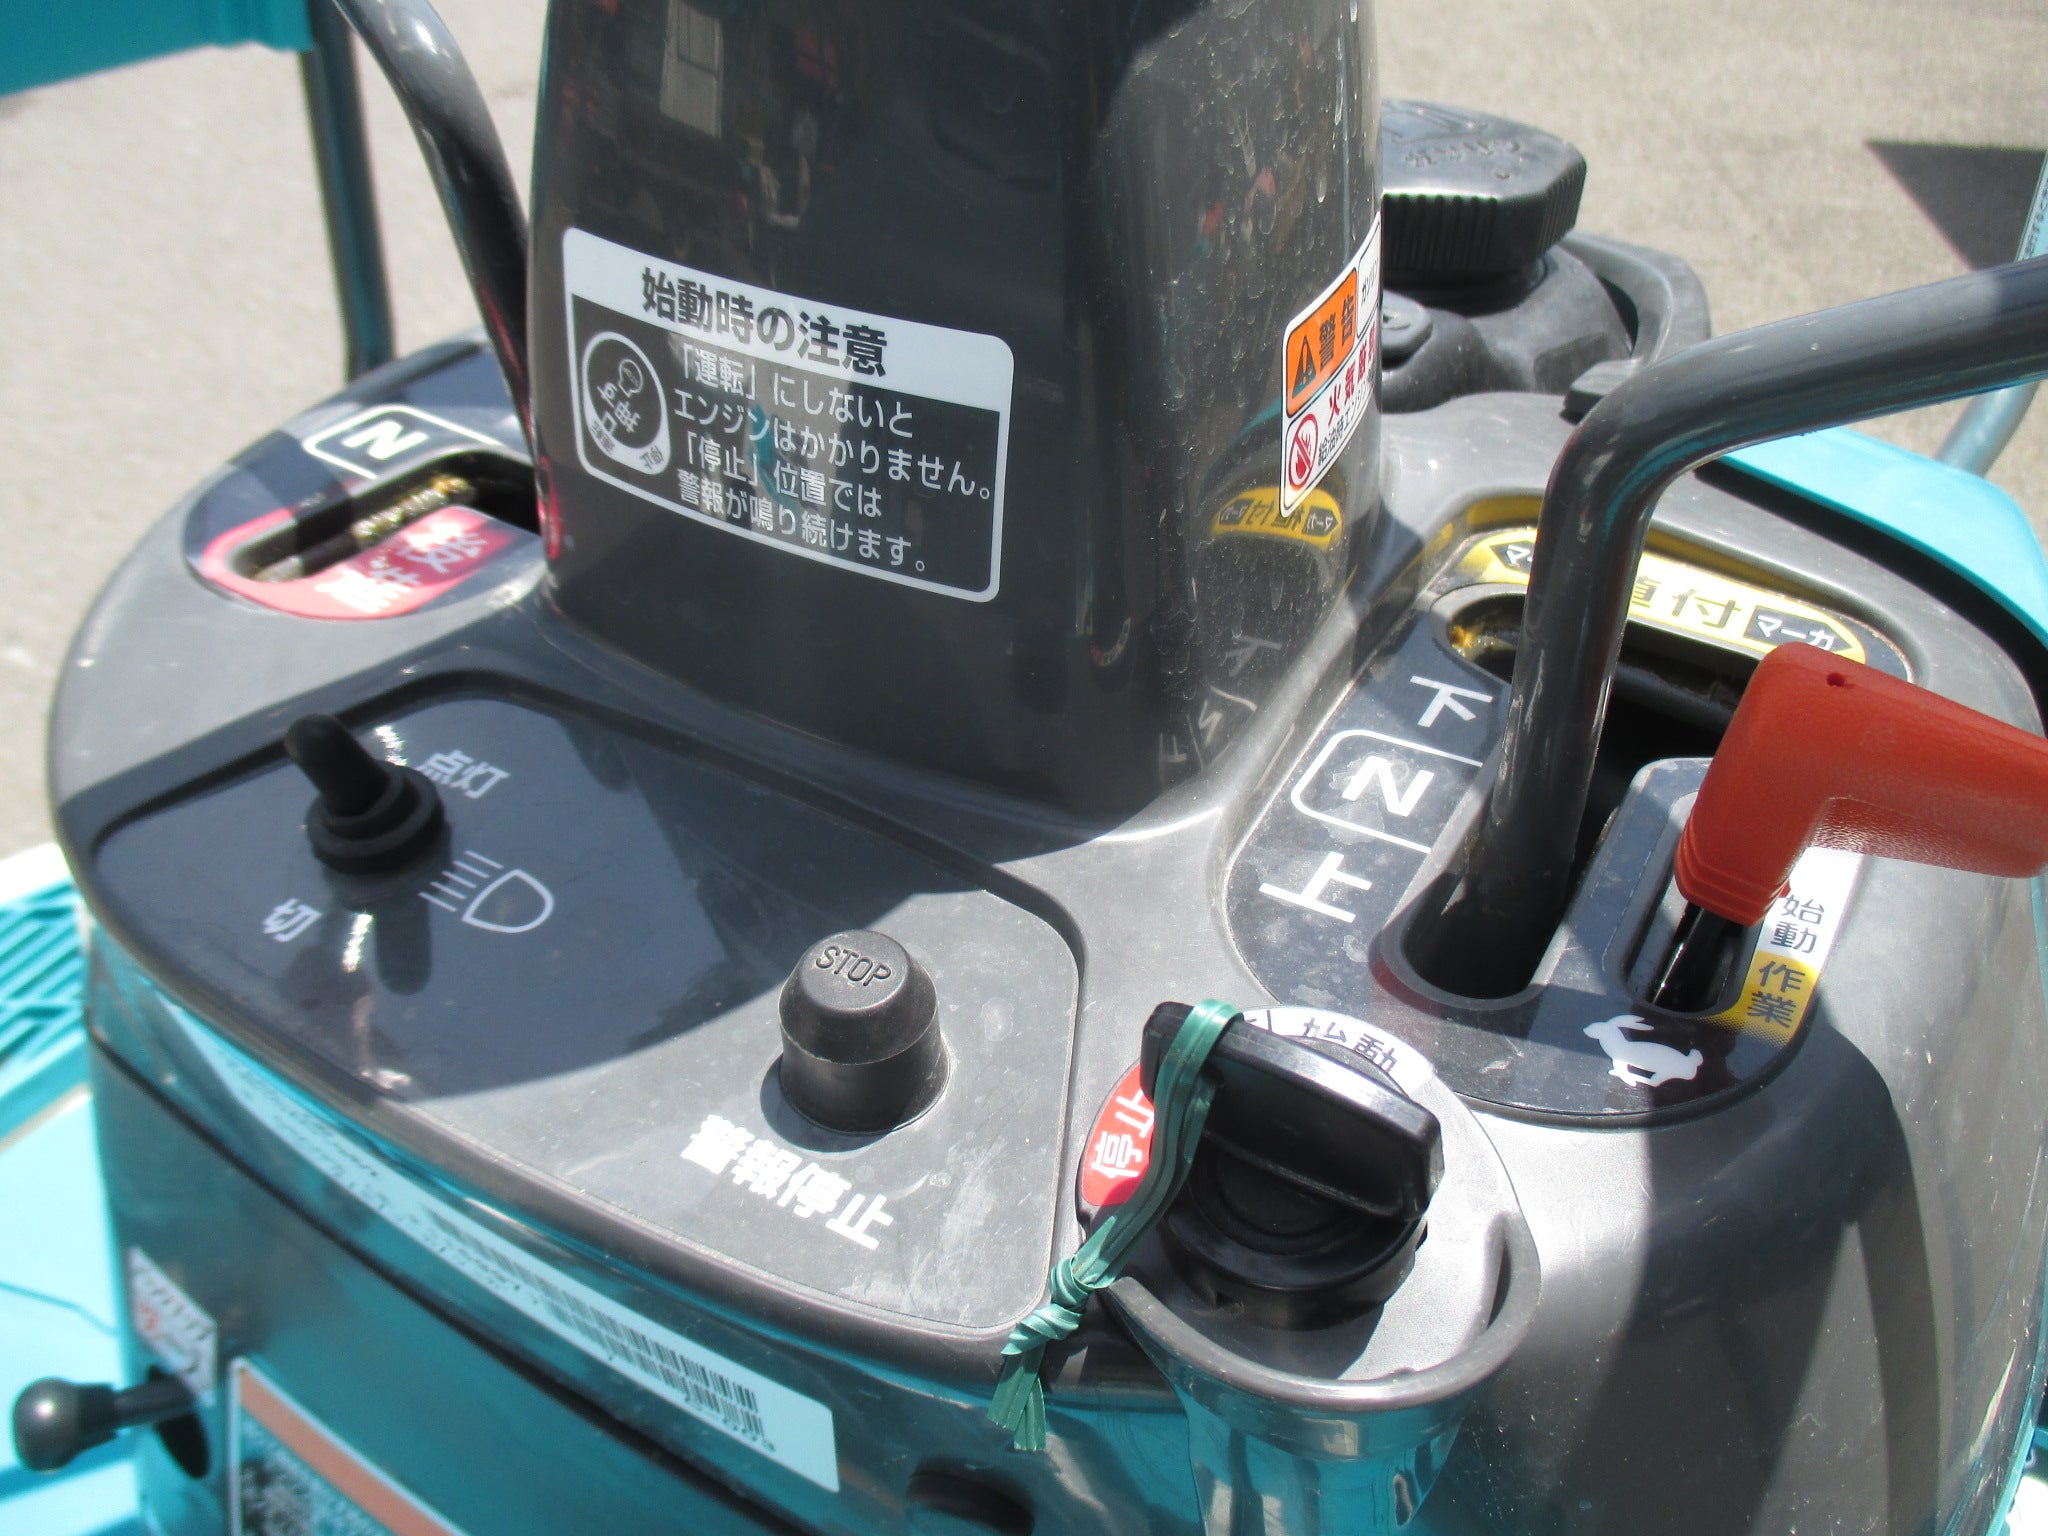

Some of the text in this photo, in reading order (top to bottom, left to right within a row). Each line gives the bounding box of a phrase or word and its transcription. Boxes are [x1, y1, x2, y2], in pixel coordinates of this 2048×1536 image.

[642, 267, 888, 377] 始動時の注意
[1318, 294, 1355, 372] 警告
[682, 345, 914, 439] 「運転」にしないと
[341, 419, 431, 461] N
[674, 388, 991, 500] エンジンはかかりません。
[686, 432, 883, 518] 「停止」位置では
[676, 470, 926, 573] 警報が鳴り続けます。
[1410, 675, 1493, 728] 下
[415, 749, 511, 799] 点灯
[1341, 755, 1435, 817] N
[262, 897, 323, 942] 切
[1258, 850, 1373, 923] 上
[1770, 893, 1826, 954] 始動
[814, 945, 893, 987] STOP
[1746, 960, 1806, 1029] 作業
[1090, 1088, 1155, 1179] 停止
[680, 1114, 895, 1251] 警報停止
